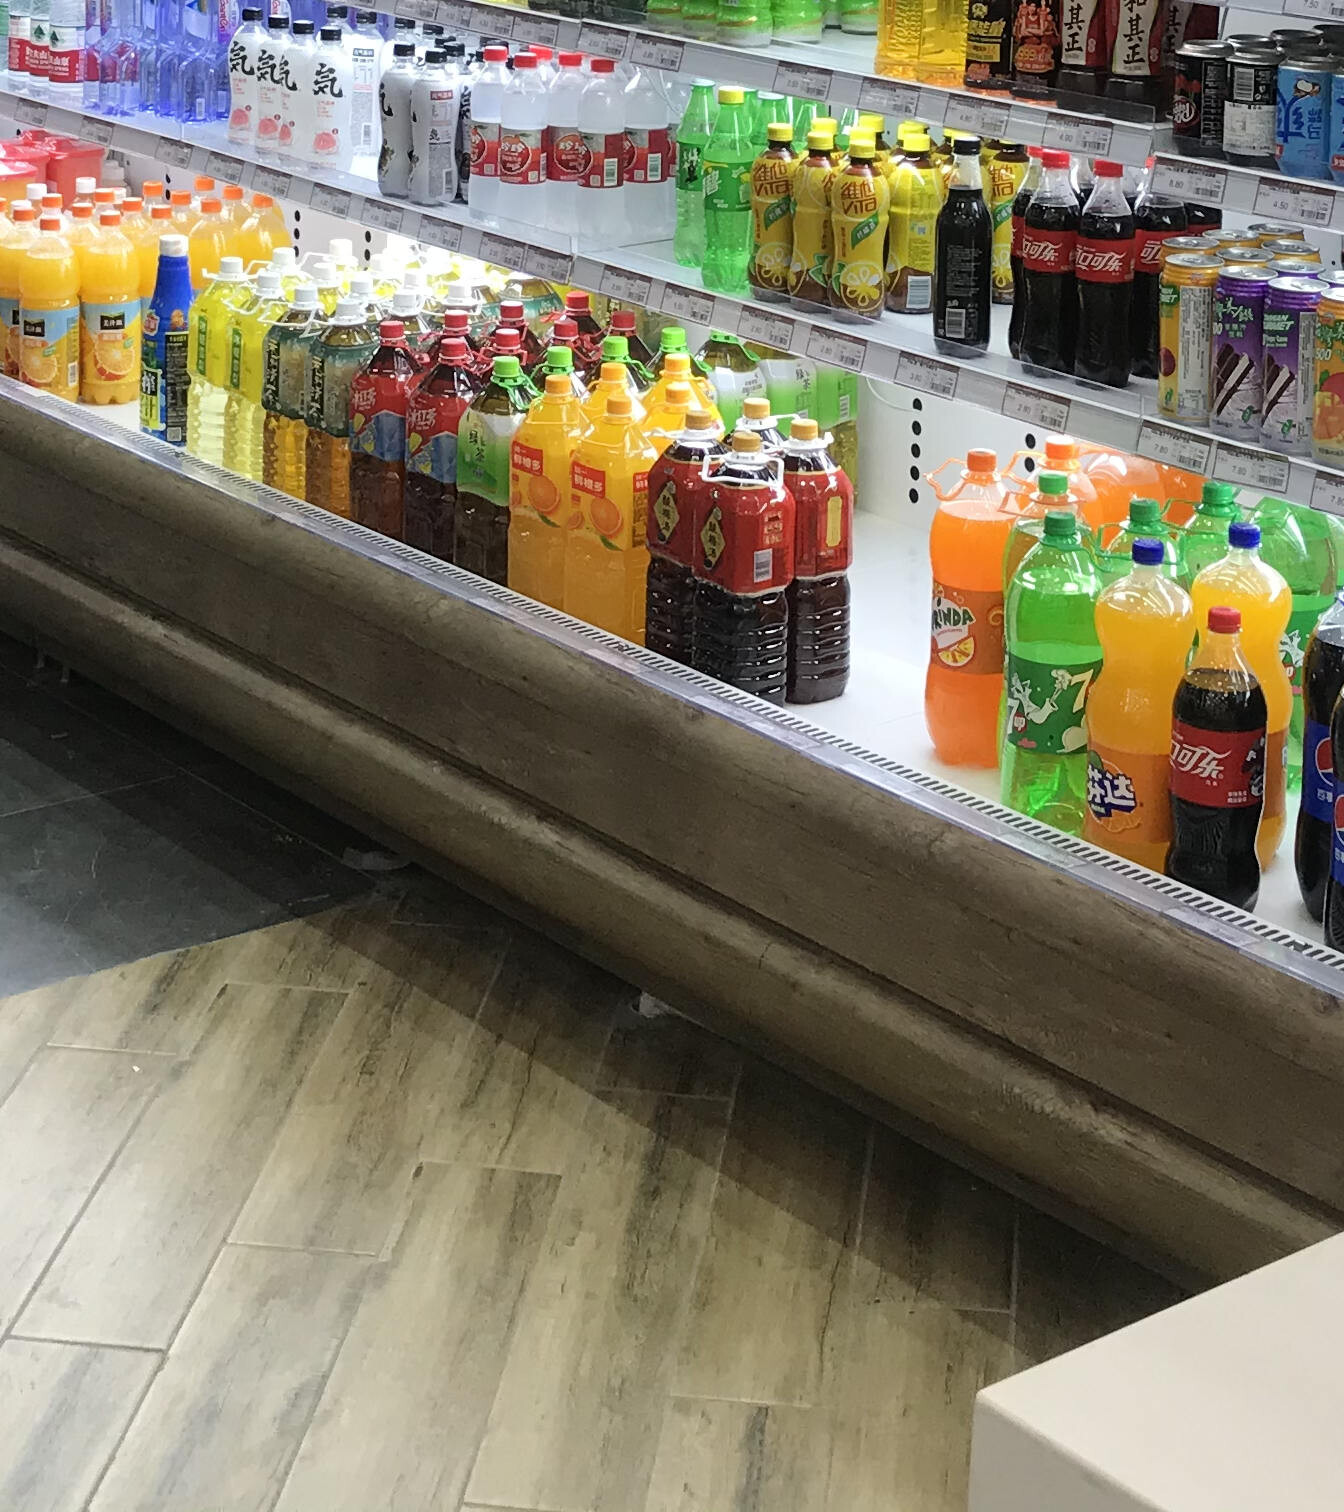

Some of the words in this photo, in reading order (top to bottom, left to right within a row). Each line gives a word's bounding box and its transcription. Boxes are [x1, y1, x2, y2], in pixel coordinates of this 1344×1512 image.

[512, 452, 543, 473] 鲜橙多
[573, 473, 604, 493] 鲜橙多
